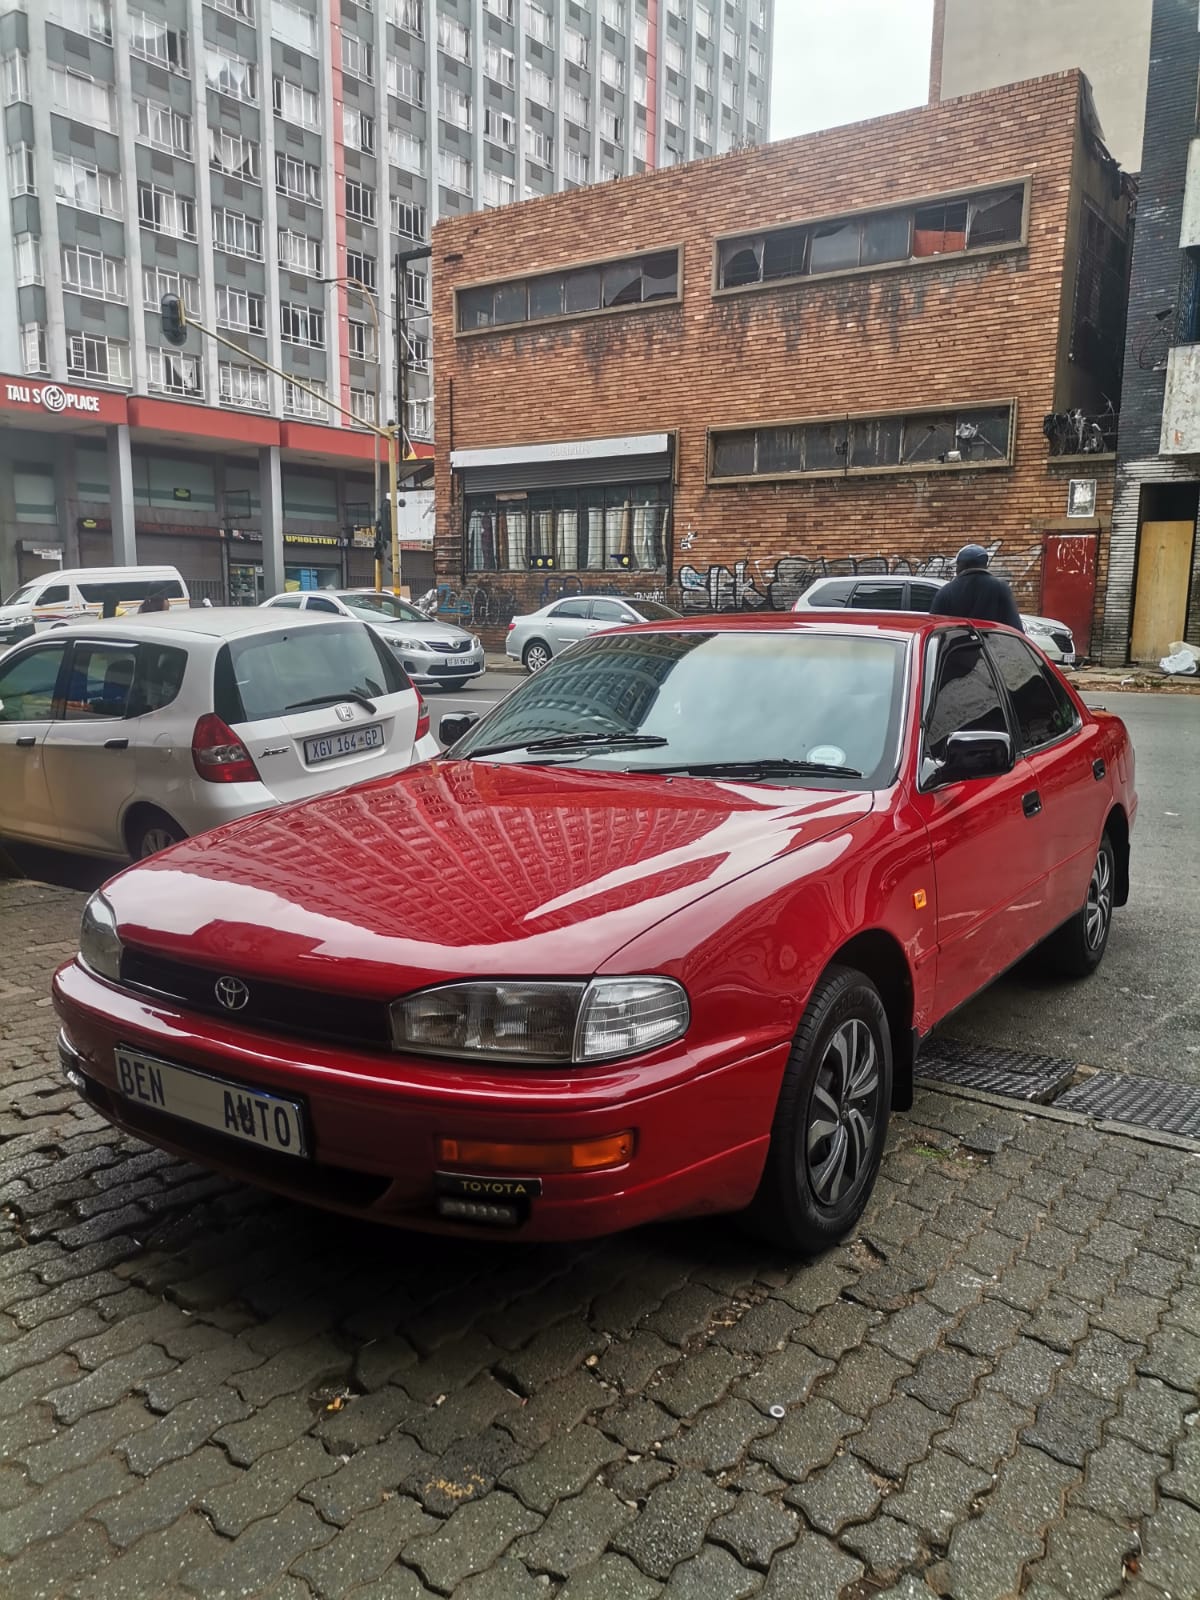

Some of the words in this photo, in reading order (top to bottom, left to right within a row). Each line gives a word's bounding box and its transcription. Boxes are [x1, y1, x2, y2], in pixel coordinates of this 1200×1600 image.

[66, 393, 100, 412] PLACE
[285, 535, 337, 545] UPHOLSTERY
[313, 739, 333, 758] XGV
[337, 734, 357, 752] 164
[365, 729, 378, 746] GP
[118, 1057, 166, 1107] BEN
[224, 1091, 291, 1147] AUTO
[461, 1181, 527, 1194] TOYOTA
